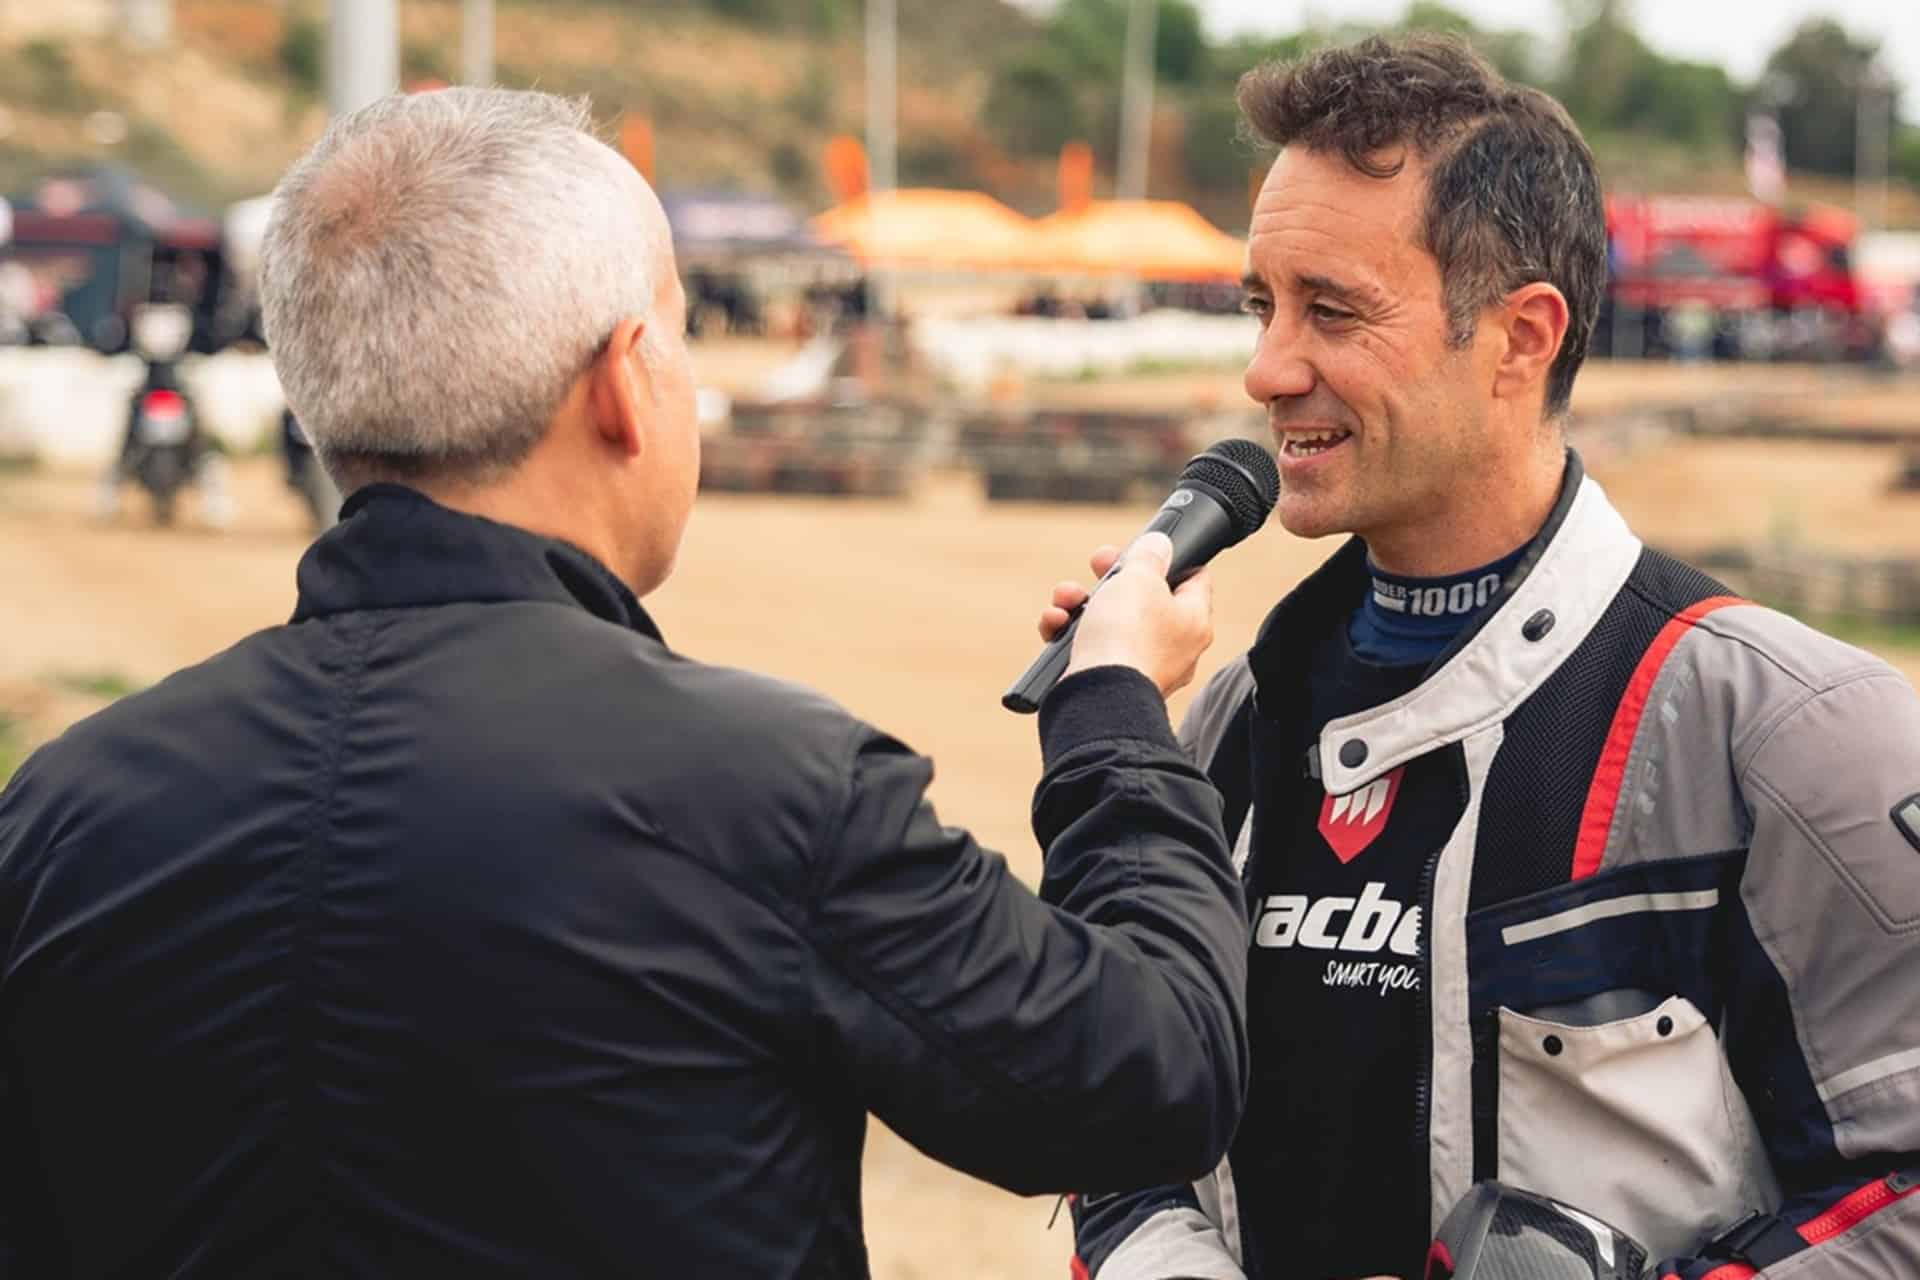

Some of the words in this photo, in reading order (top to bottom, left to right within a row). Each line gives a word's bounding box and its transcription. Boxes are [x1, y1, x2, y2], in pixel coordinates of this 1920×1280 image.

[1408, 573, 1500, 616] 1000
[1251, 882, 1422, 956] acb
[1322, 960, 1380, 988] SMART
